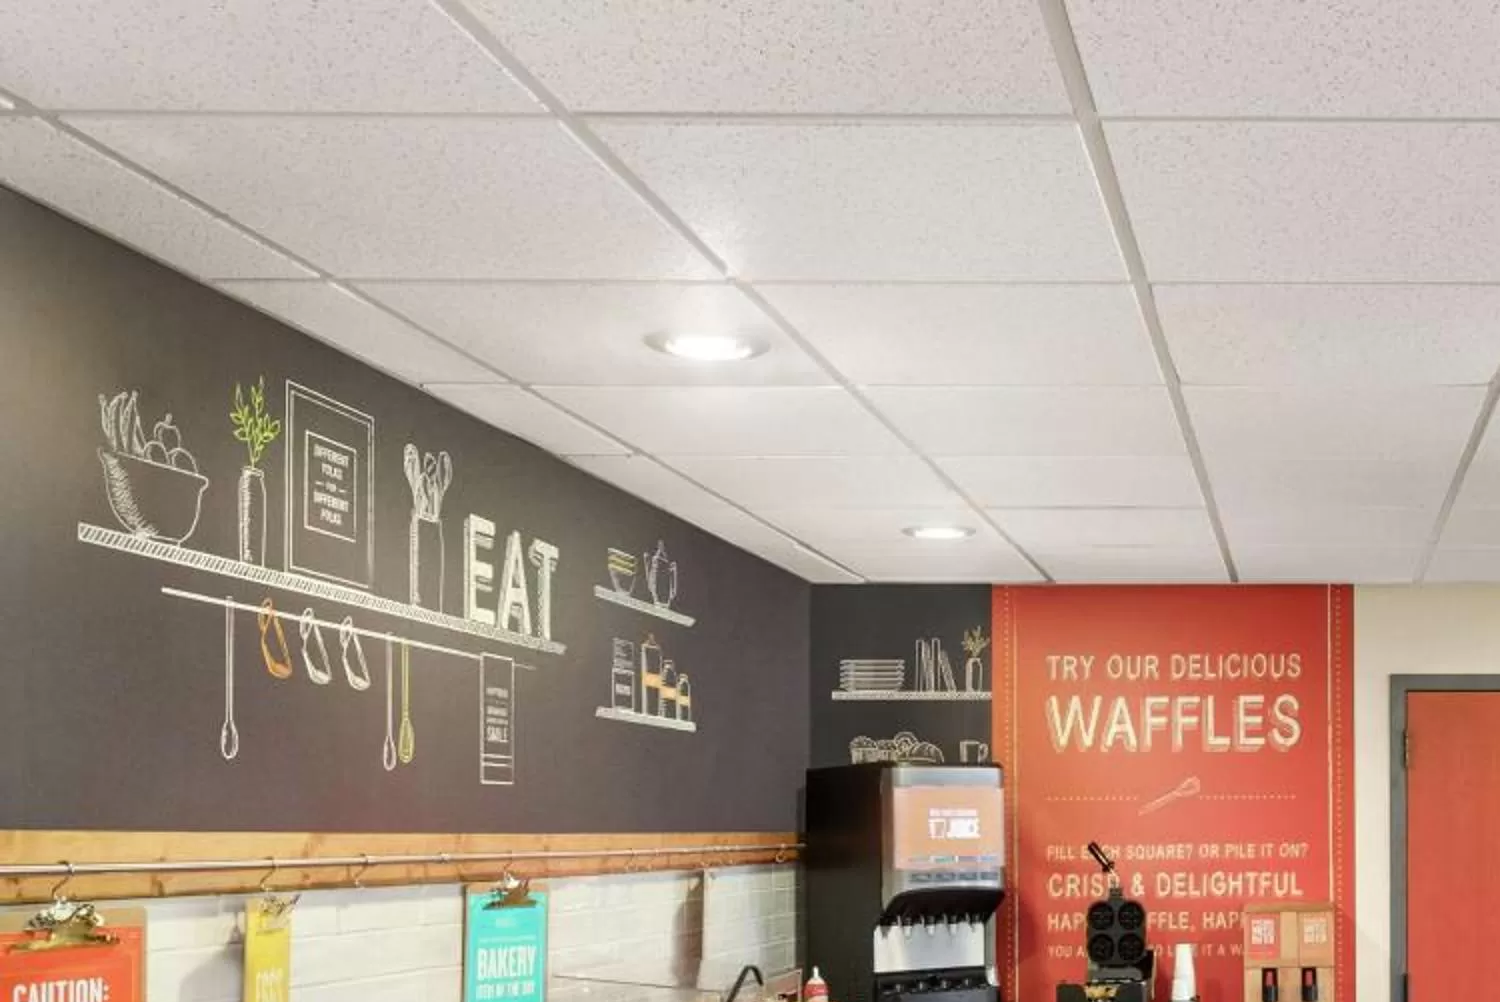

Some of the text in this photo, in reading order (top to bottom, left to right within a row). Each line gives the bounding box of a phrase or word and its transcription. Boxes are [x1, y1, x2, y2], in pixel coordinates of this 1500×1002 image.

[463, 513, 559, 641] EAT
[1046, 653, 1302, 680] TRY OUR DELICIOUS
[1046, 694, 1302, 752] WAFFLES
[1047, 842, 1309, 860] FILL ECH SQUARE? OR PILE IT ON?
[1131, 872, 1145, 897] &
[1156, 871, 1304, 897] DELIGHTFUL
[1147, 911, 1196, 932] FFLE,
[477, 945, 537, 981] BAKERY
[1047, 944, 1073, 958] YOU
[1201, 943, 1212, 957] IT
[1217, 943, 1226, 957] A
